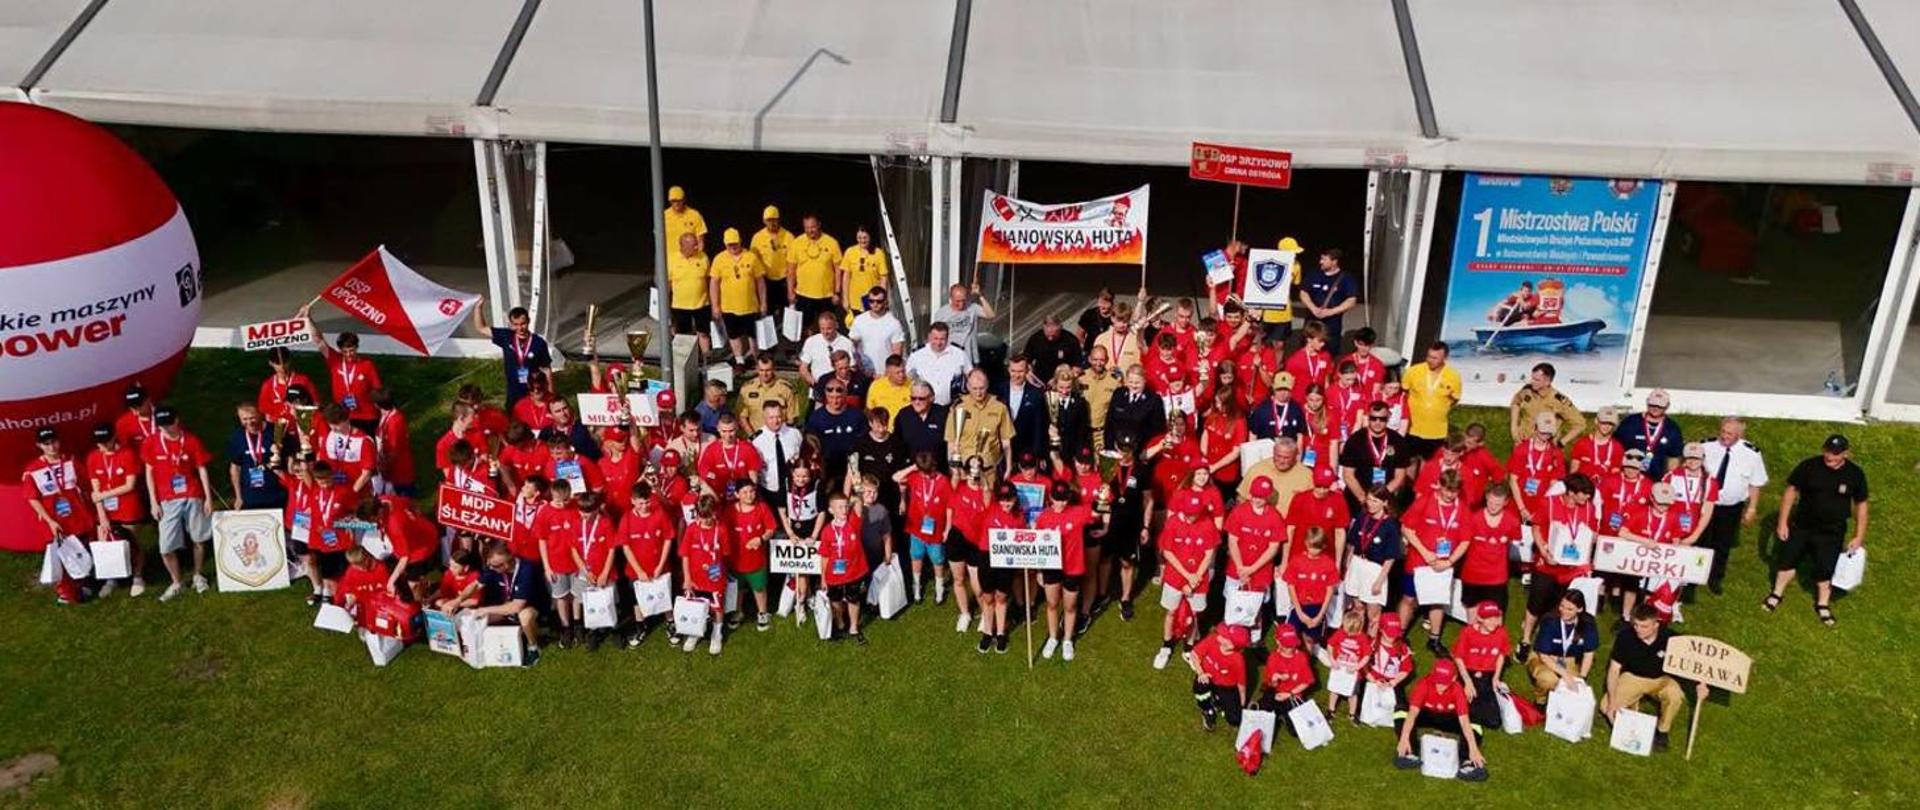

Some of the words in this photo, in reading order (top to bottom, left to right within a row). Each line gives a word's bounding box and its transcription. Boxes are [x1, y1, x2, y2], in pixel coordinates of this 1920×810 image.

[1220, 153, 1237, 164] OSP
[1499, 207, 1590, 232] Mistrzostwa
[1591, 211, 1639, 233] Polski
[992, 229, 1085, 246] SIANOWSKA
[1092, 230, 1133, 245] HUTA
[345, 277, 371, 294] OSP
[50, 284, 156, 324] maszyny
[330, 286, 387, 326] OPOCZNO
[0, 313, 127, 358] ower
[247, 320, 306, 340] MDP
[246, 333, 309, 349] OPOCZNO
[461, 494, 495, 512] MDP
[442, 503, 511, 533] ŚLĘŻANY
[775, 545, 817, 560] MDP
[992, 543, 1037, 556] SIANOWSKA
[1038, 545, 1059, 556] HUTA
[1635, 545, 1677, 560] OSP
[1616, 558, 1686, 578] JURKI
[1688, 640, 1730, 660] MDP
[1667, 655, 1743, 687] LUBAWA
